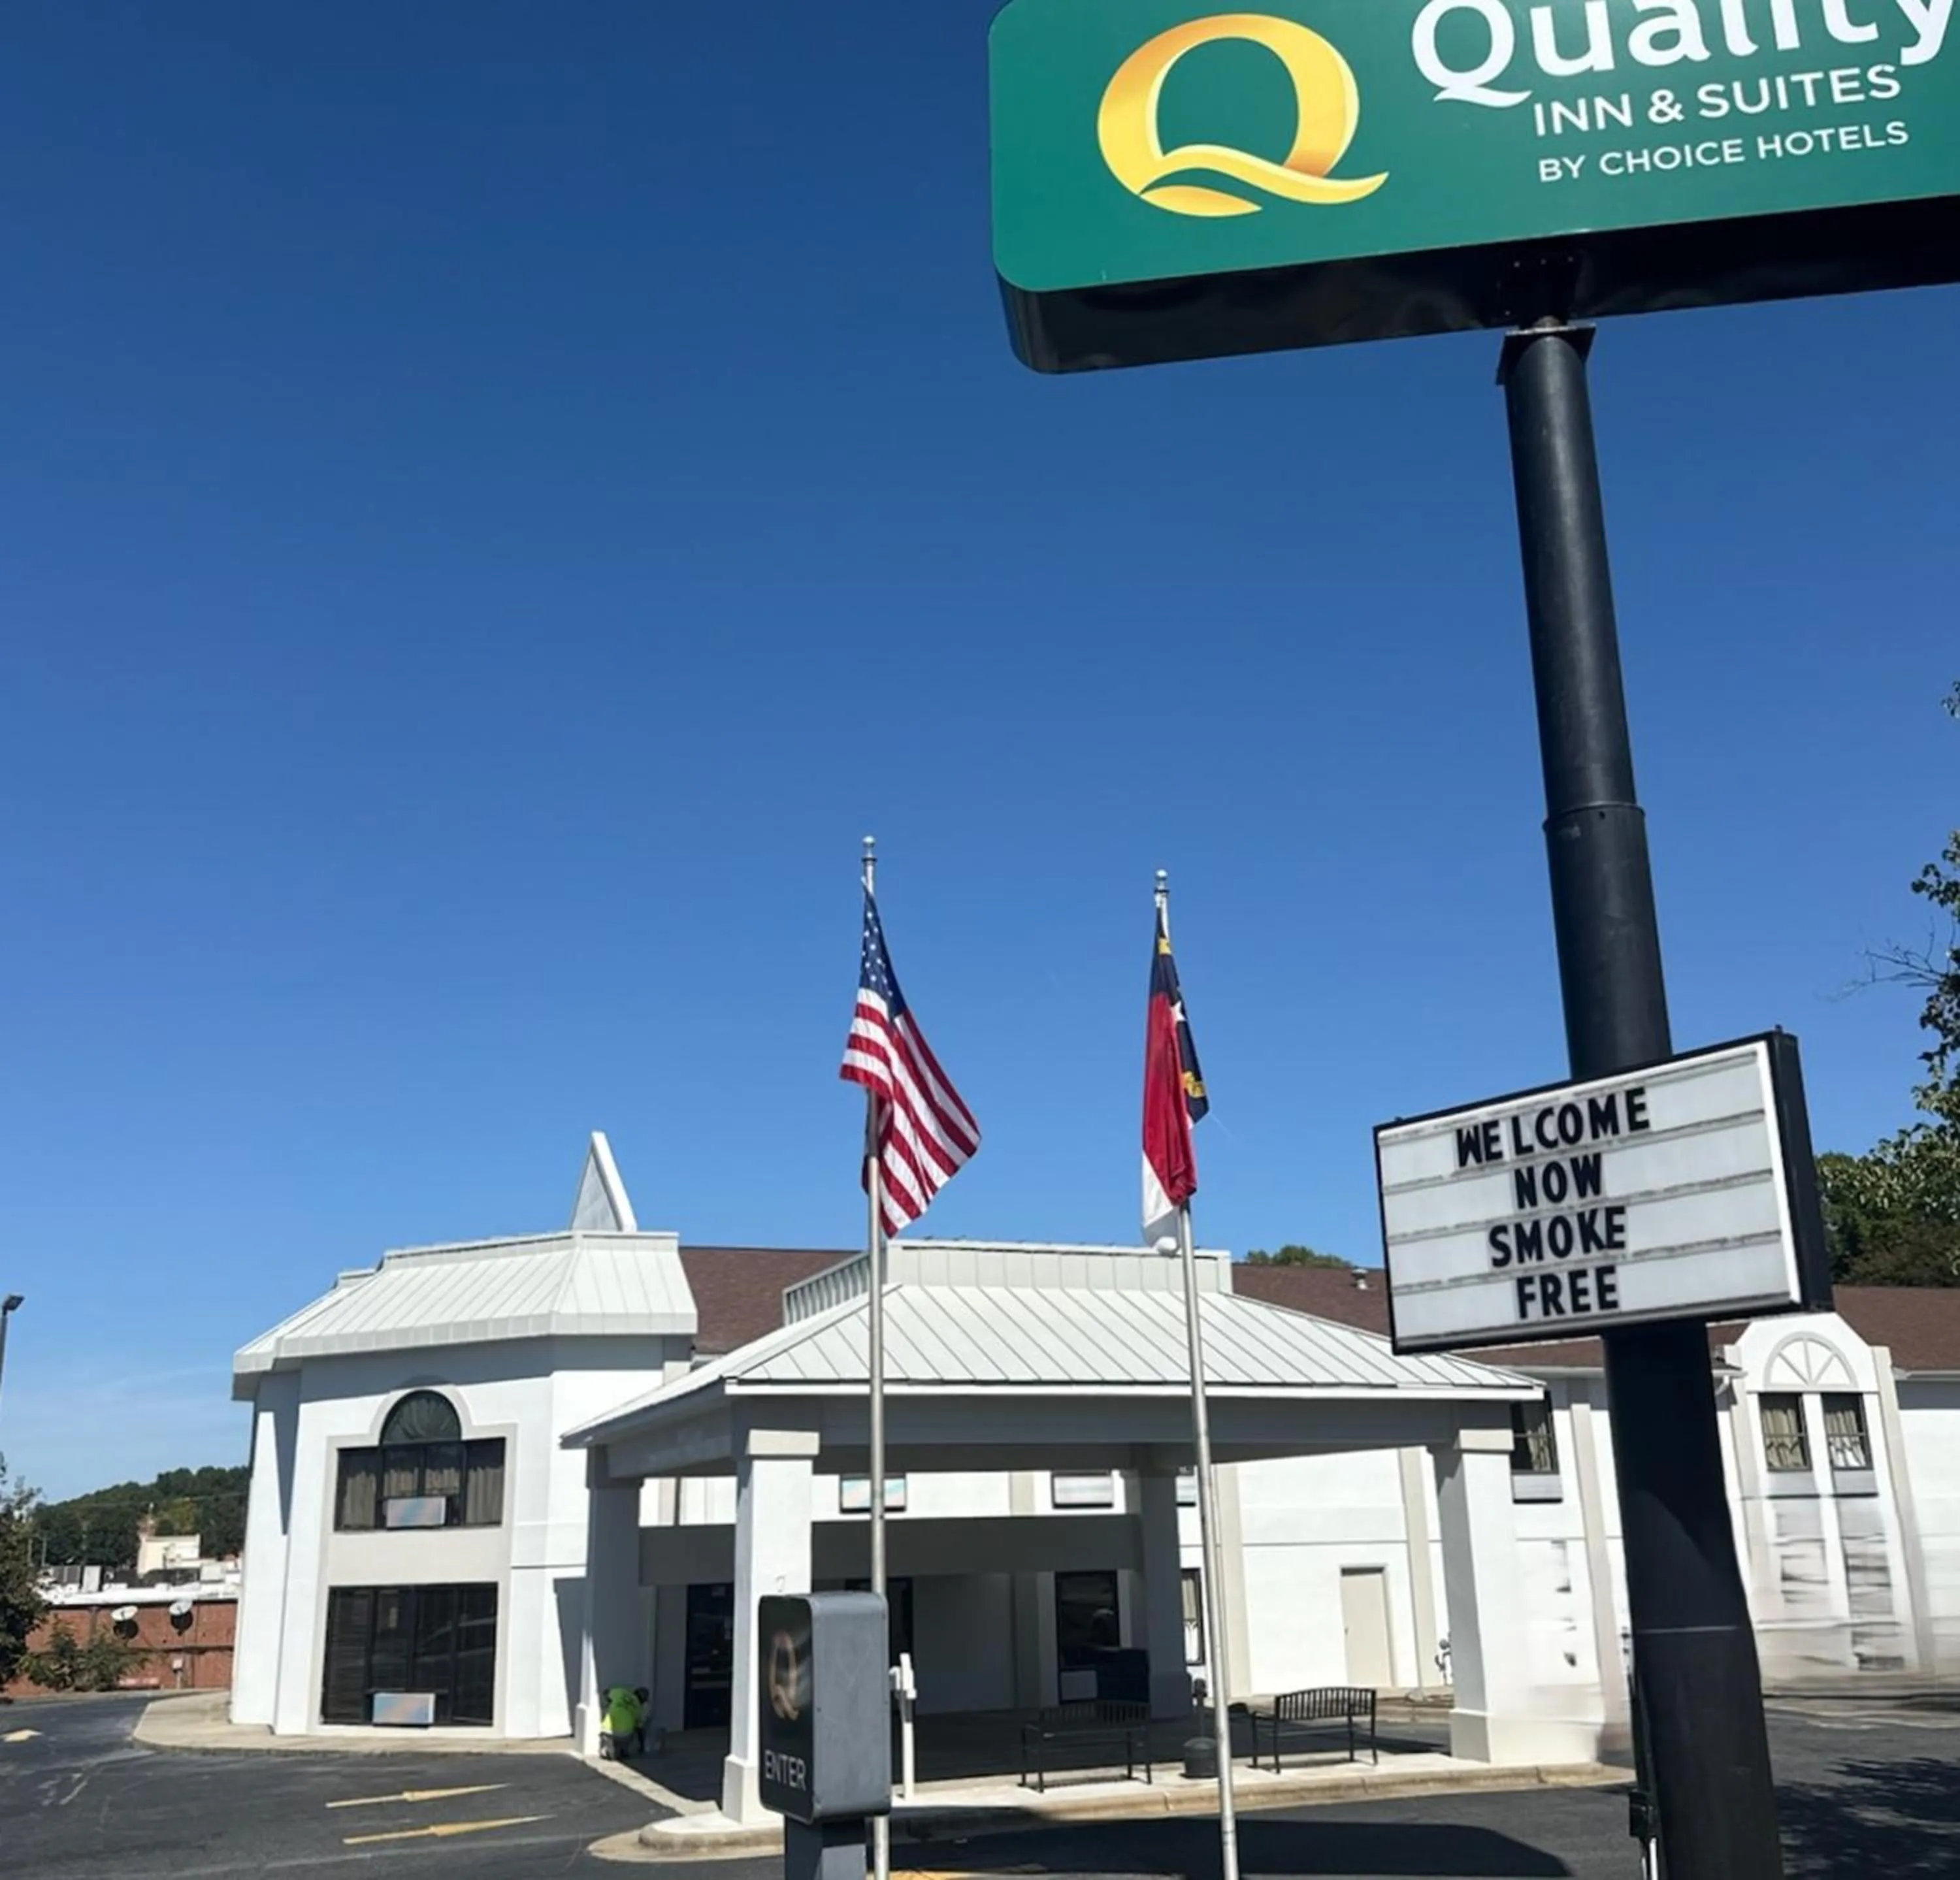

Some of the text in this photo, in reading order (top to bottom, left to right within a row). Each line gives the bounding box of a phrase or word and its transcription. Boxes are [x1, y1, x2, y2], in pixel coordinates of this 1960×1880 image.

[1098, 13, 1390, 217] Q
[1533, 64, 1901, 136] INN & SUITES
[1539, 121, 1909, 182] BY CHOICE HOTELS
[1455, 1086, 1651, 1168] WELCOME
[1514, 1152, 1602, 1210] NOW
[1488, 1205, 1626, 1269] SMOKE
[1516, 1264, 1620, 1320] FREE
[764, 1749, 807, 1791] ENTER
